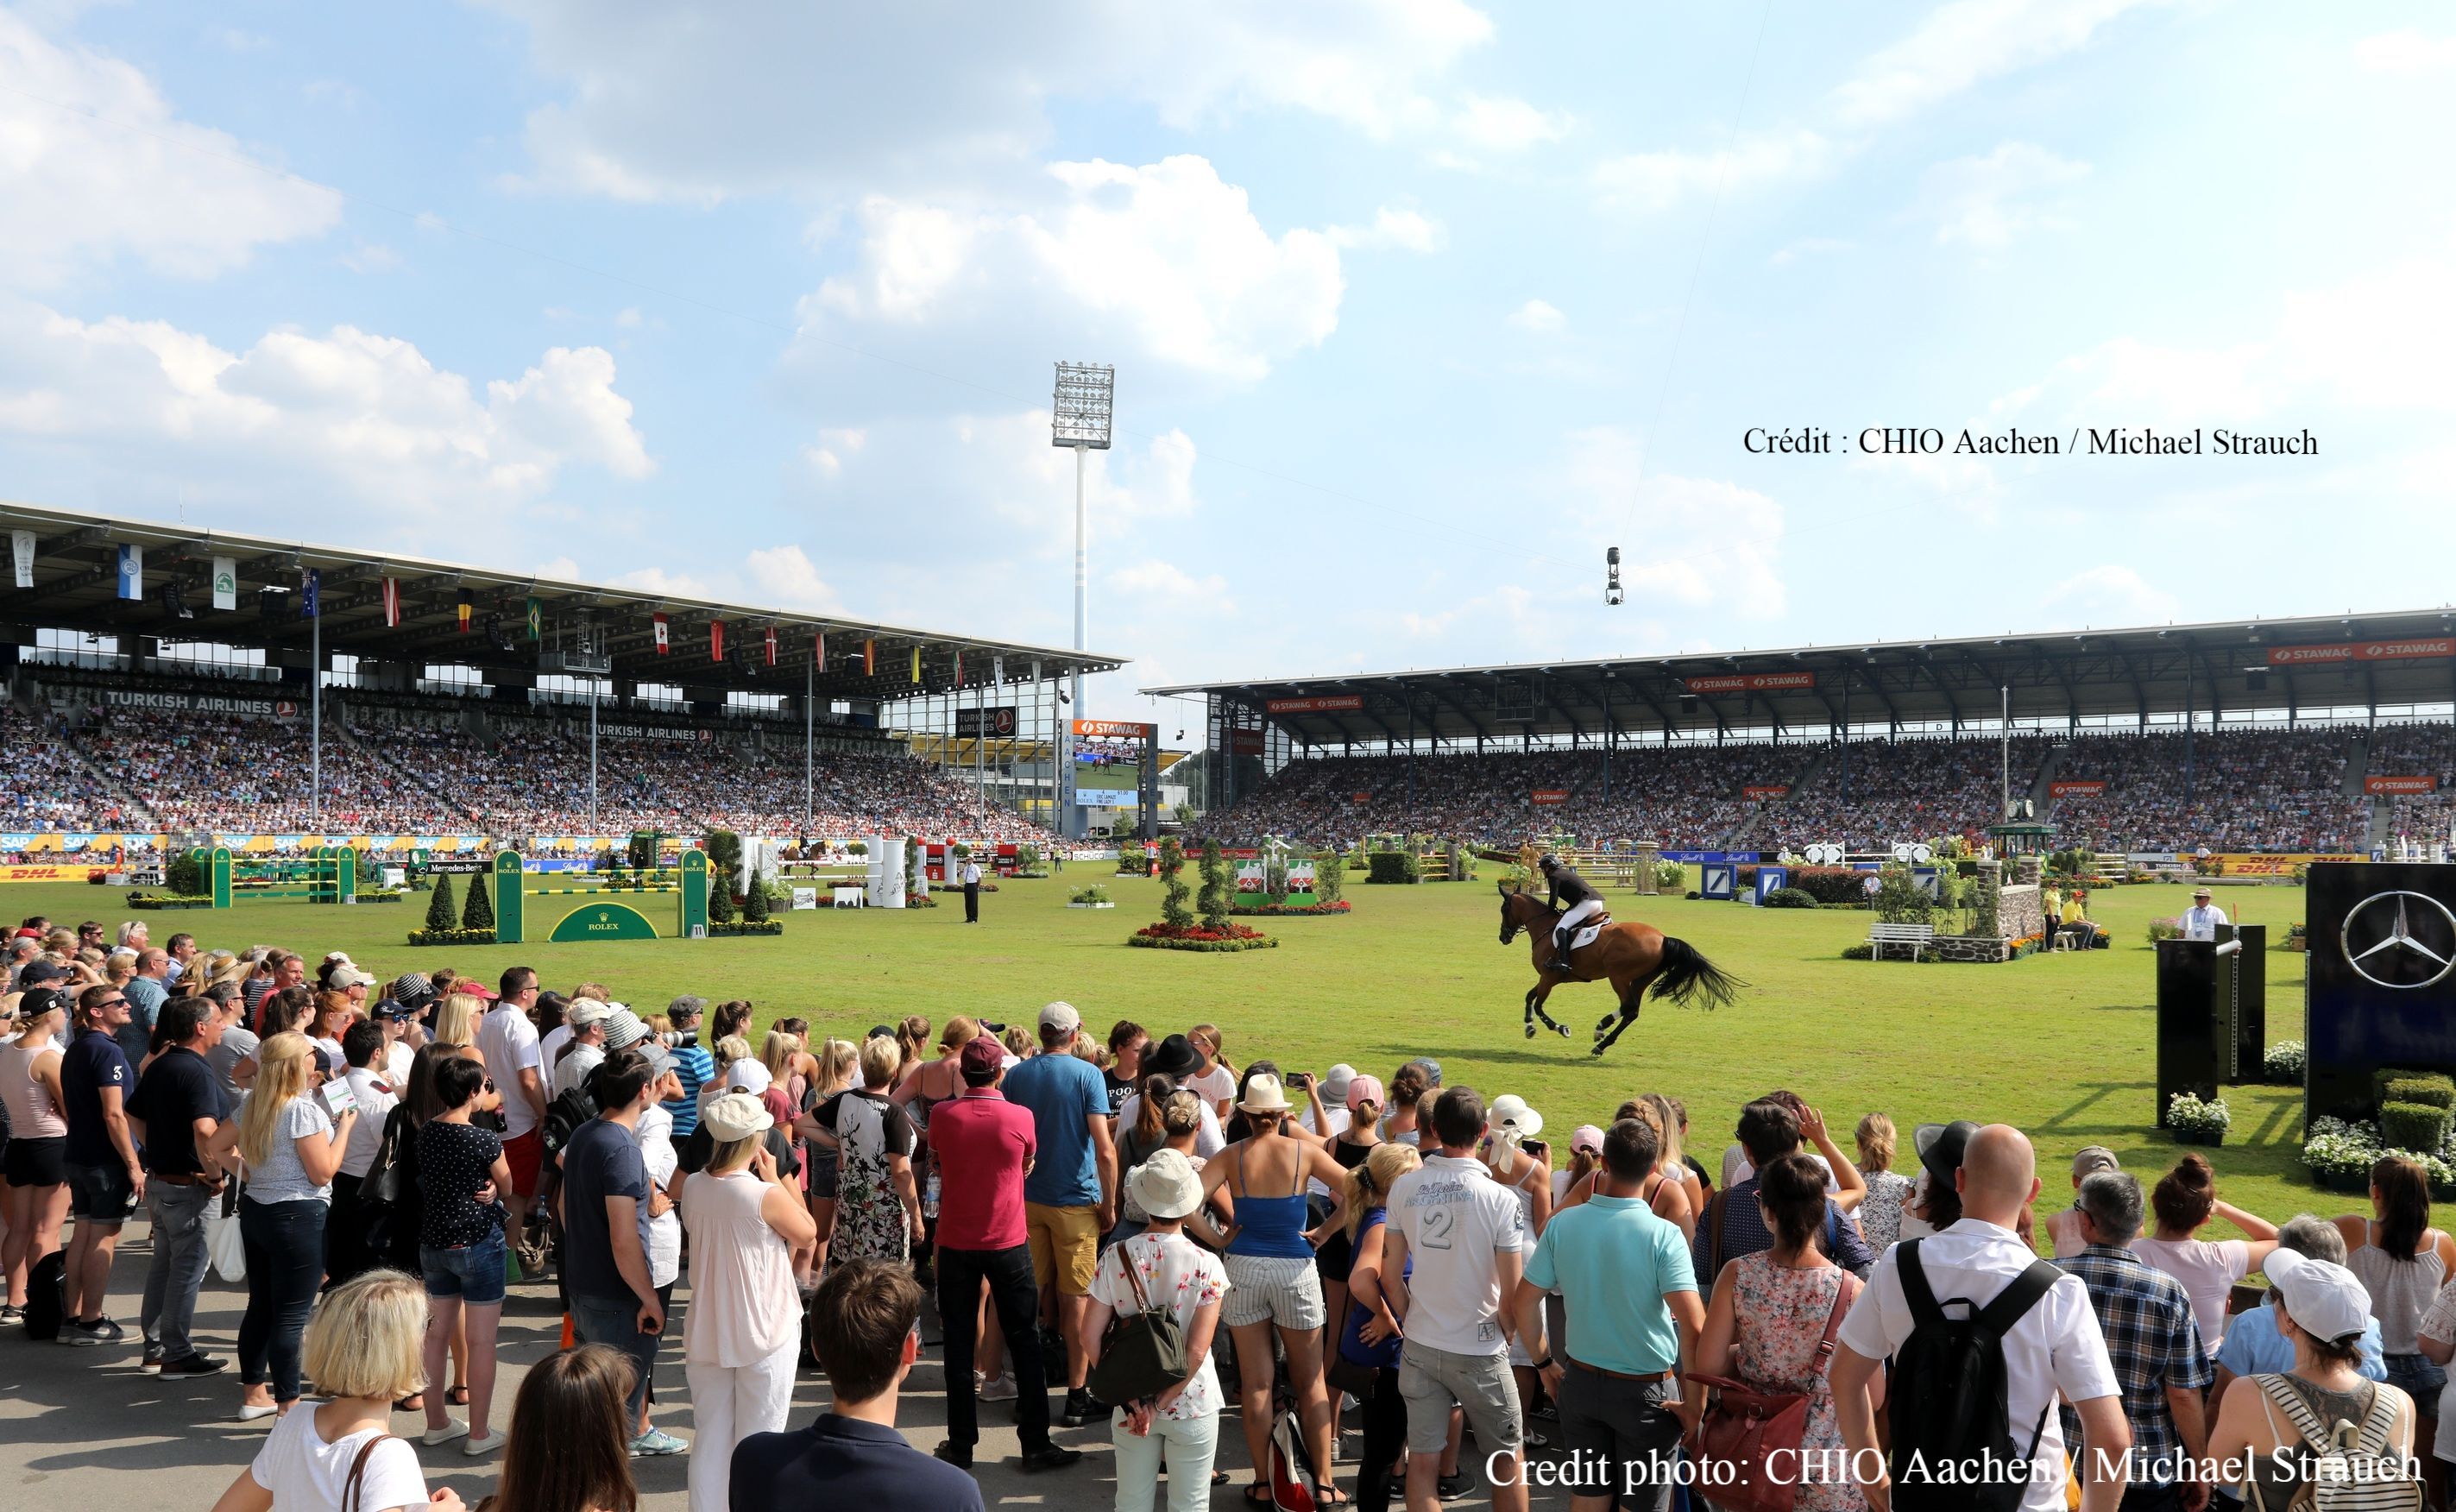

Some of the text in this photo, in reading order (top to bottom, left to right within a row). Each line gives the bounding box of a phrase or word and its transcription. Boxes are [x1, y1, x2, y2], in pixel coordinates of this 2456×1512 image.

[2293, 643, 2447, 659] STAWAG STAWAG
[1704, 676, 1808, 689] STAWAG STAWAG
[107, 691, 272, 715] TURKISH AIRLINES
[959, 714, 994, 722] TURKSH
[959, 723, 994, 733] AIRLIES
[1096, 723, 1139, 734] STAWAG
[646, 728, 696, 740] AIRLINES
[1237, 736, 1263, 747] STAWAG
[1, 837, 29, 848] SAP
[274, 838, 298, 849] SAP
[371, 839, 392, 849] SAP
[415, 840, 436, 849] SAP
[458, 840, 477, 849] SAP
[563, 863, 583, 872] Lindt
[2237, 865, 2283, 873] DHL
[10, 869, 60, 879] DHL
[695, 926, 702, 936] 11
[113, 1065, 123, 1080] 3
[1108, 1087, 1136, 1097] POO
[1420, 1204, 1453, 1250] 2
